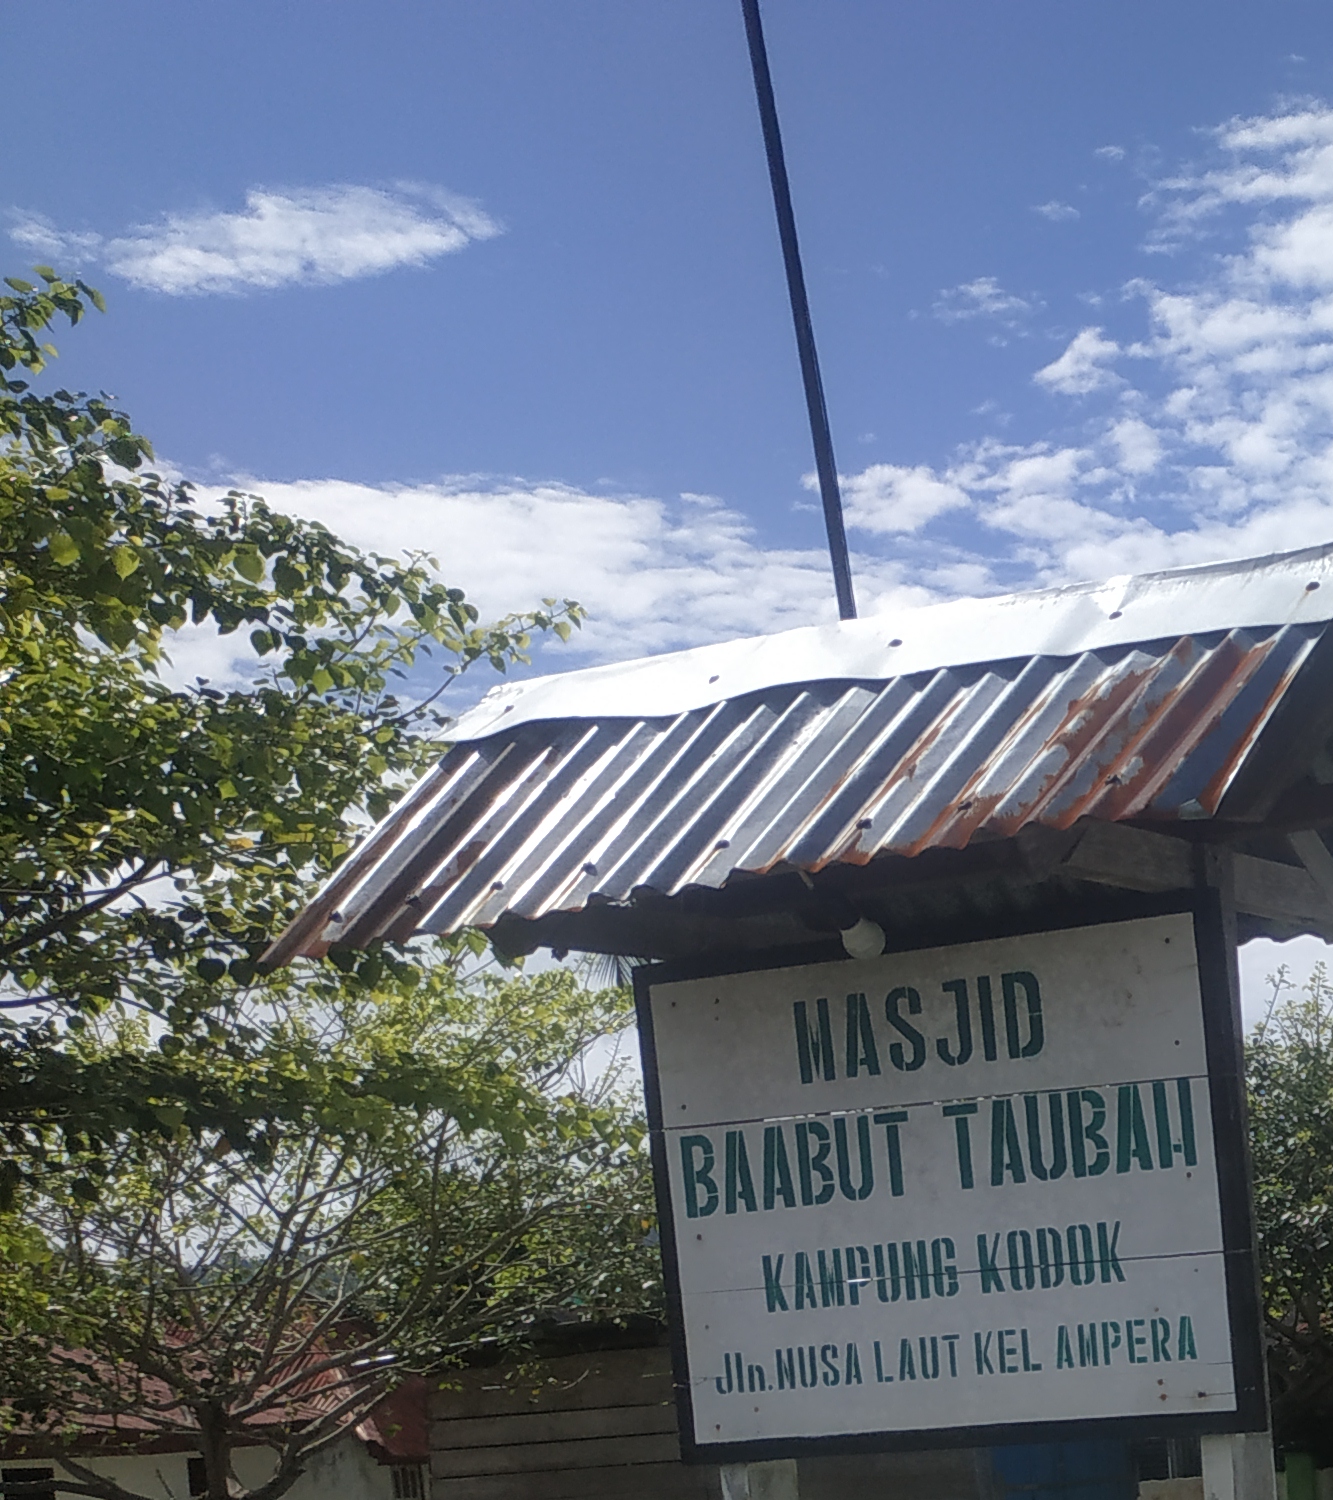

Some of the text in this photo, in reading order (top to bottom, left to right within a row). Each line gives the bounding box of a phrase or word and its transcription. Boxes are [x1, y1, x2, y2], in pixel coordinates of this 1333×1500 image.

[793, 970, 1045, 1085] MASJID
[679, 1077, 1198, 1219] BAABUT TAUBAH
[762, 1220, 1126, 1313] KAMPUNG KODOK
[873, 1334, 960, 1383] LAUT
[974, 1328, 1042, 1375] KEL
[1056, 1315, 1198, 1370] AMPERA
